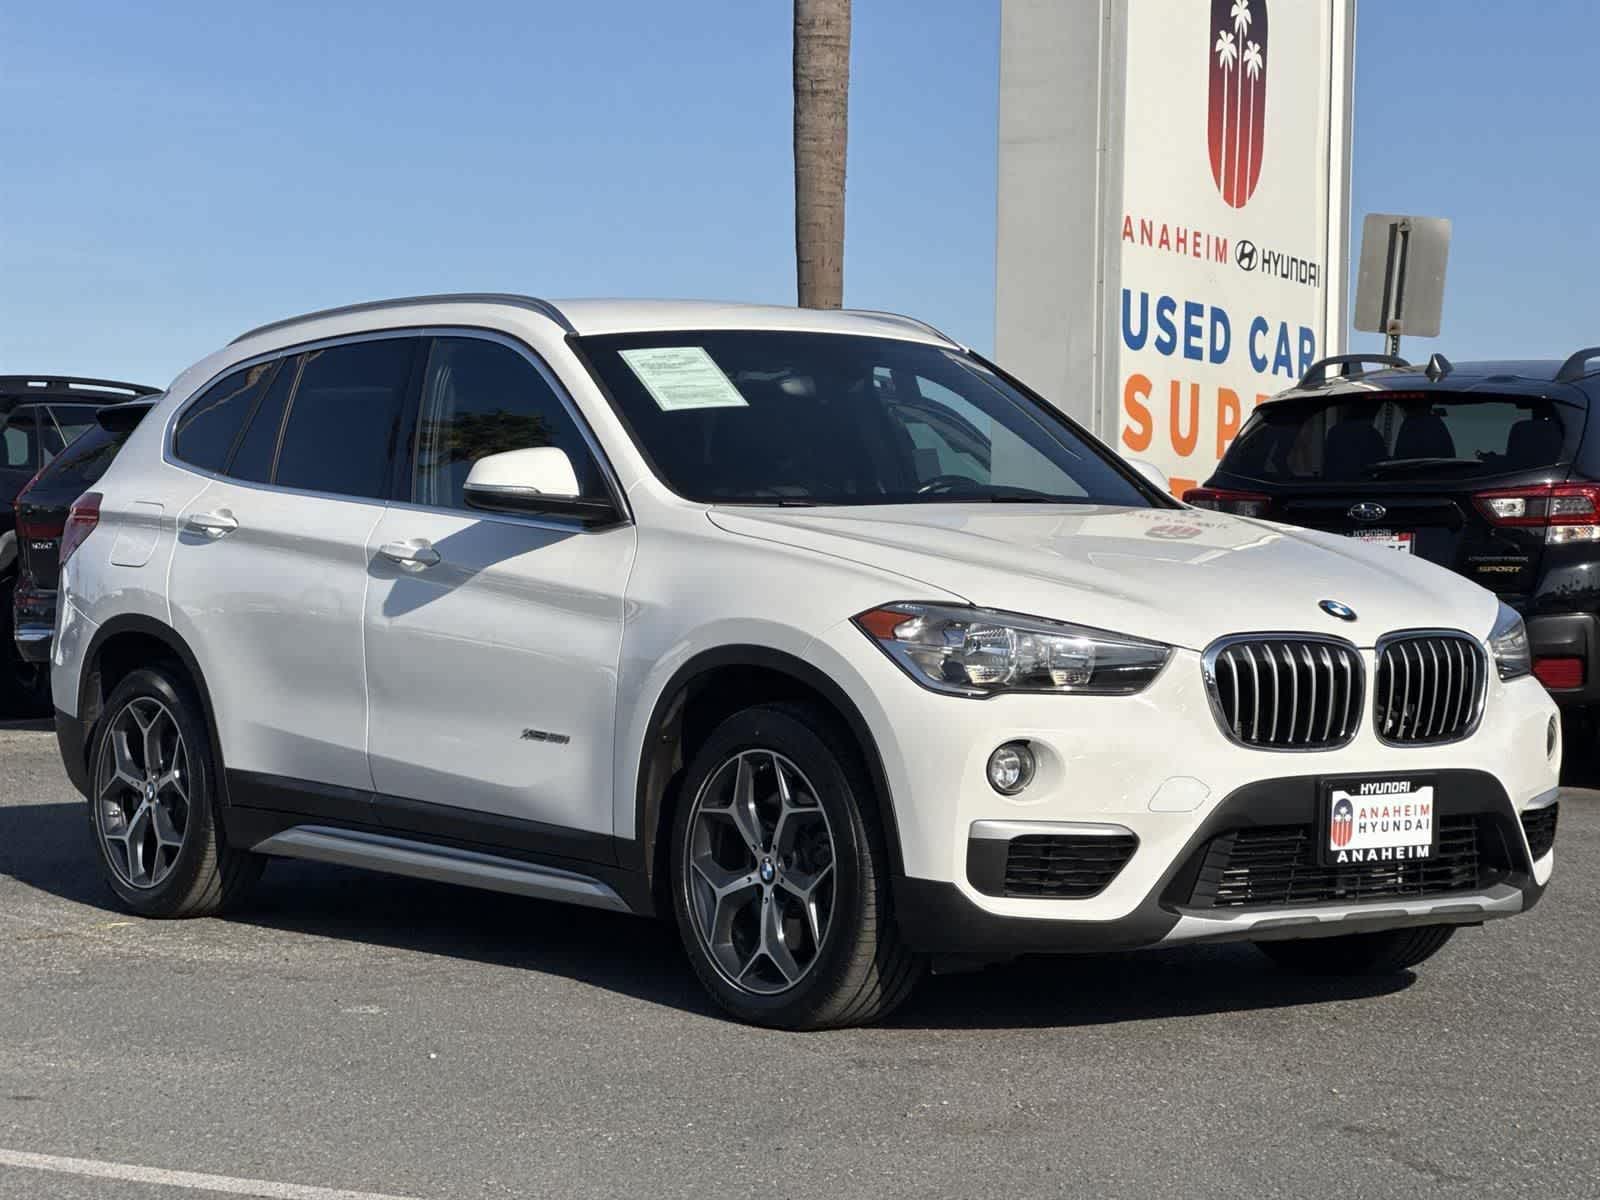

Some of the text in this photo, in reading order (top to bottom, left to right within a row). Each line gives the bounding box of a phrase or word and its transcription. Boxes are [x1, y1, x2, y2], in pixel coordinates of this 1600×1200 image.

[1122, 215, 1321, 288] ANAHEIM HYUNDAI
[1122, 287, 1316, 379] USED CAR
[1122, 373, 1272, 460] SUP
[1360, 781, 1411, 795] HYUNDAI
[1359, 804, 1430, 820] ANAHEIM
[1359, 819, 1430, 834] HYUNDAI
[1336, 845, 1430, 863] ANAHEIM
